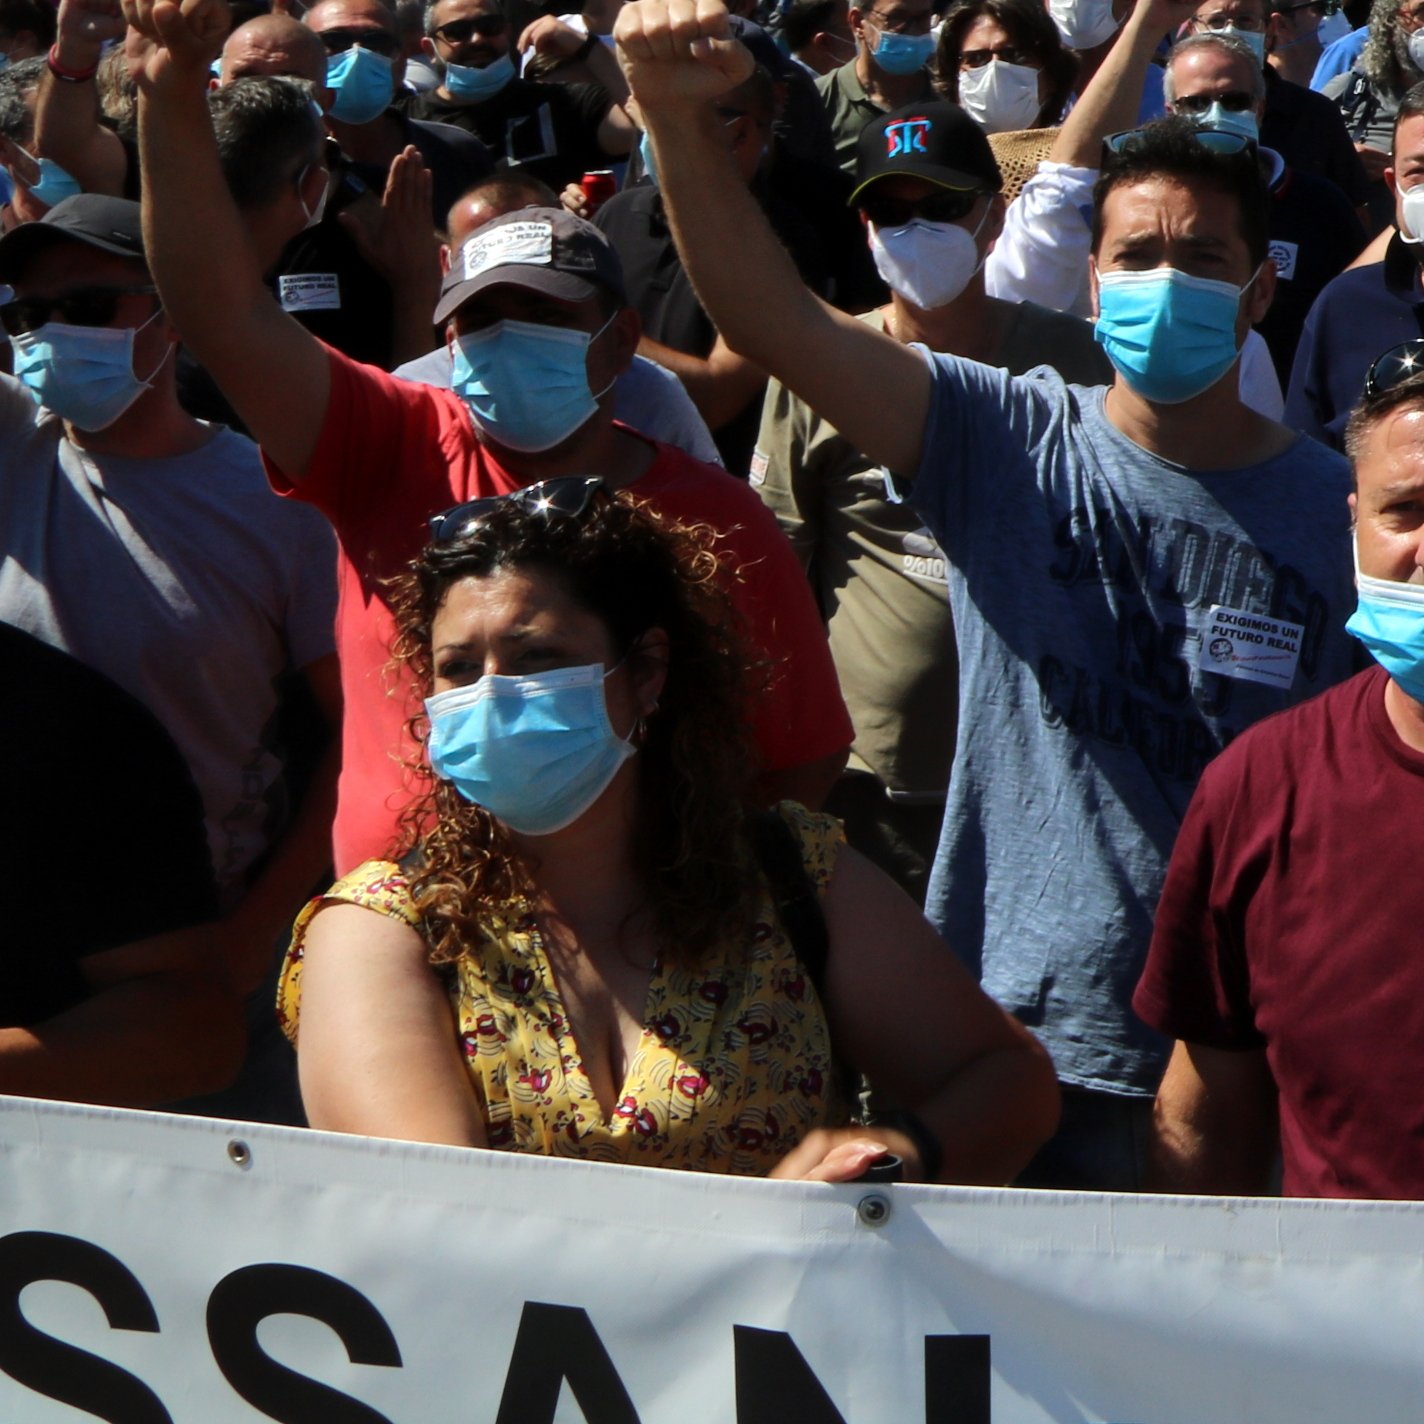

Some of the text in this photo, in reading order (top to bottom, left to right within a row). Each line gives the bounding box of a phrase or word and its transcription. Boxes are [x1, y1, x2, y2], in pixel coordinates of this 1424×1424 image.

[1211, 624, 1298, 653] FUTURO REAL
[1216, 612, 1300, 639] EXIGIMOS UN
